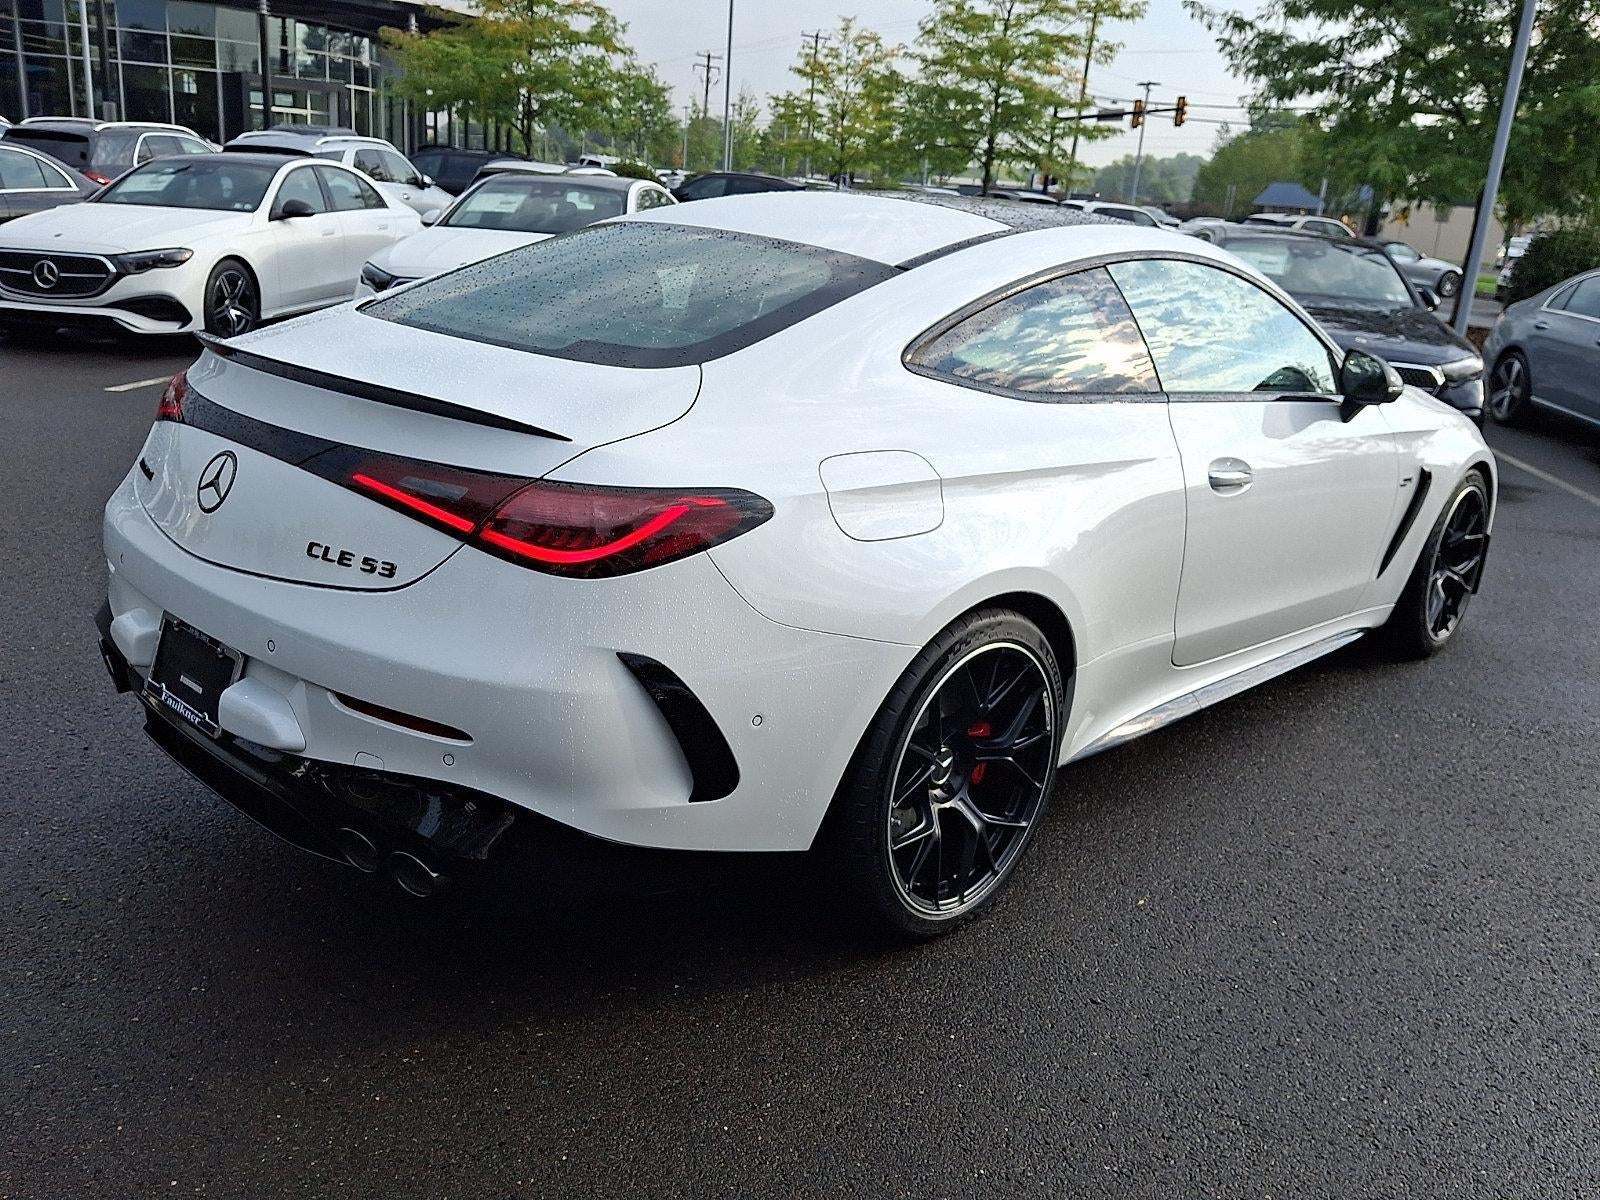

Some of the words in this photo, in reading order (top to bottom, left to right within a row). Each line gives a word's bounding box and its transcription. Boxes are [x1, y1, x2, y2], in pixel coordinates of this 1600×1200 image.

[306, 541, 356, 568] CLE
[359, 556, 398, 579] 53
[161, 690, 202, 725] Faulkner
